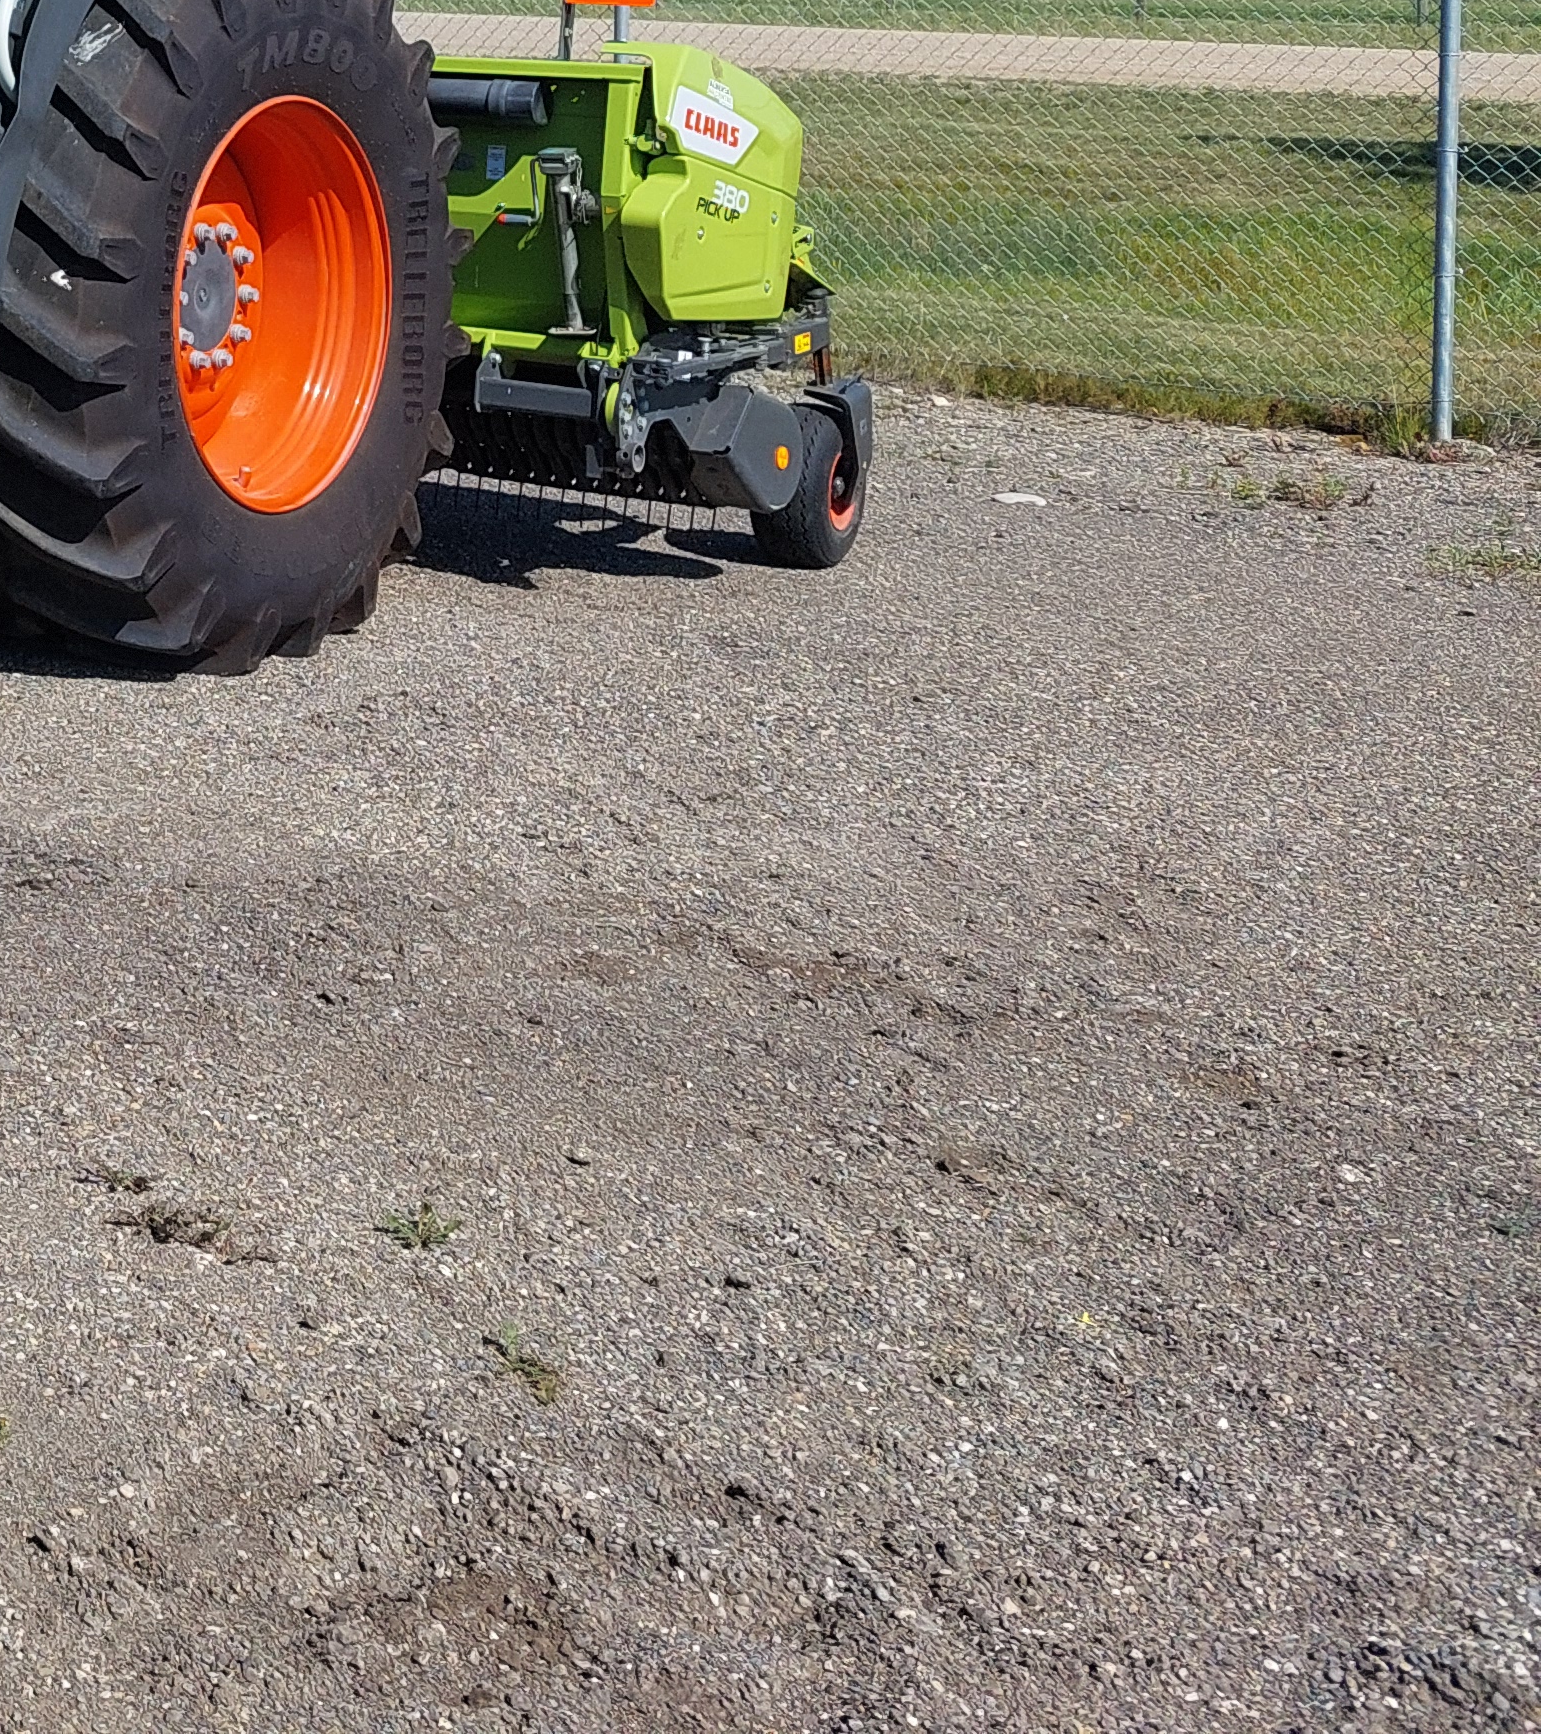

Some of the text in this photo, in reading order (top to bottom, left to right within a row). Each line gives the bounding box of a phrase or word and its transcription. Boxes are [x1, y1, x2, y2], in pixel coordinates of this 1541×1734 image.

[684, 108, 740, 148] CLAAS
[696, 197, 740, 223] PICK UP
[713, 180, 749, 214] 380
